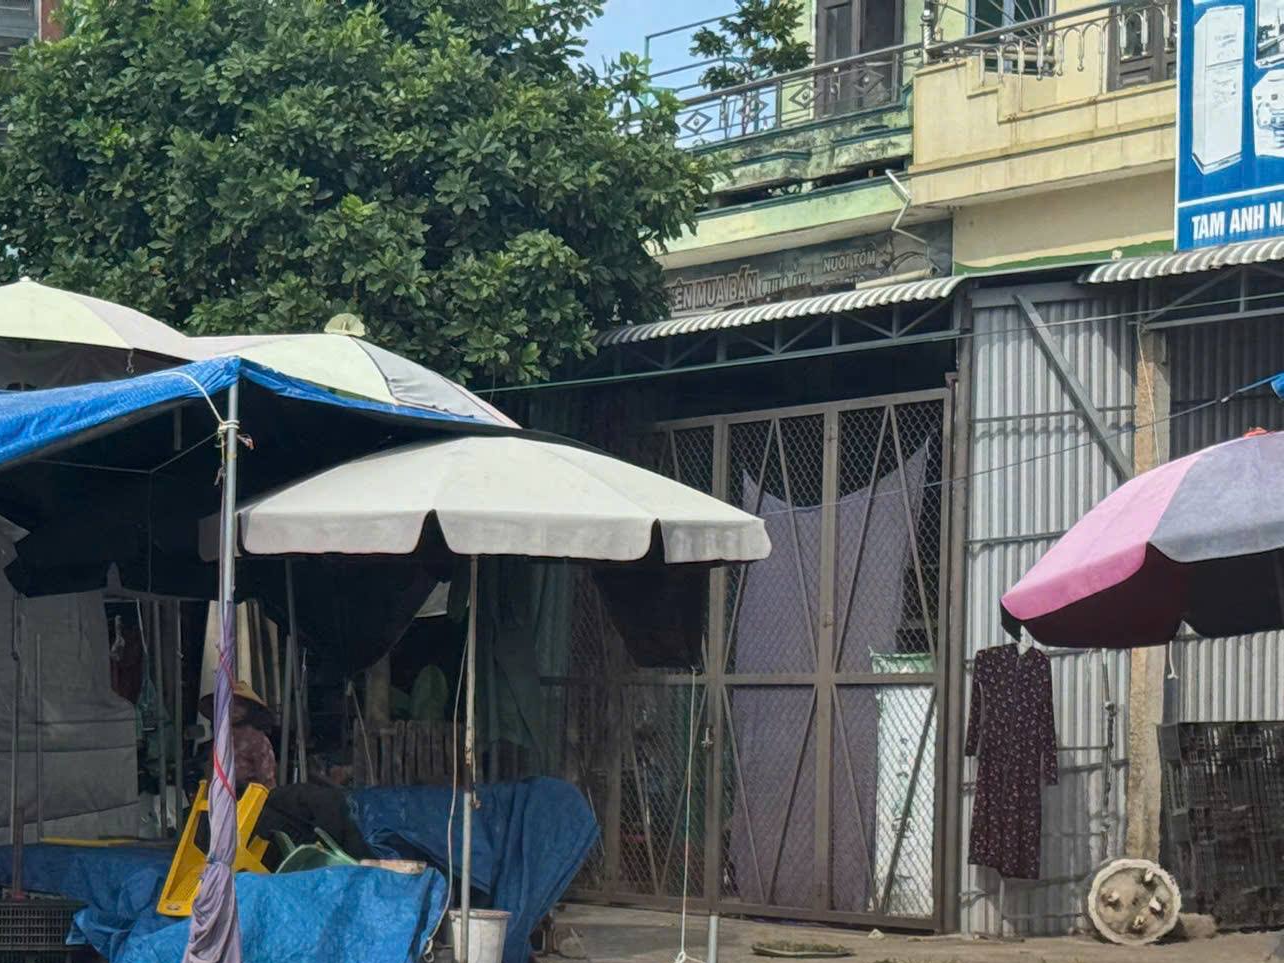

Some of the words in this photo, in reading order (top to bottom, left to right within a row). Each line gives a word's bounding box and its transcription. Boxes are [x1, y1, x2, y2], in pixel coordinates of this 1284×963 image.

[1191, 211, 1225, 241] TAM
[1229, 204, 1265, 234] ANH
[1269, 201, 1284, 228] N
[694, 276, 726, 309] MUA
